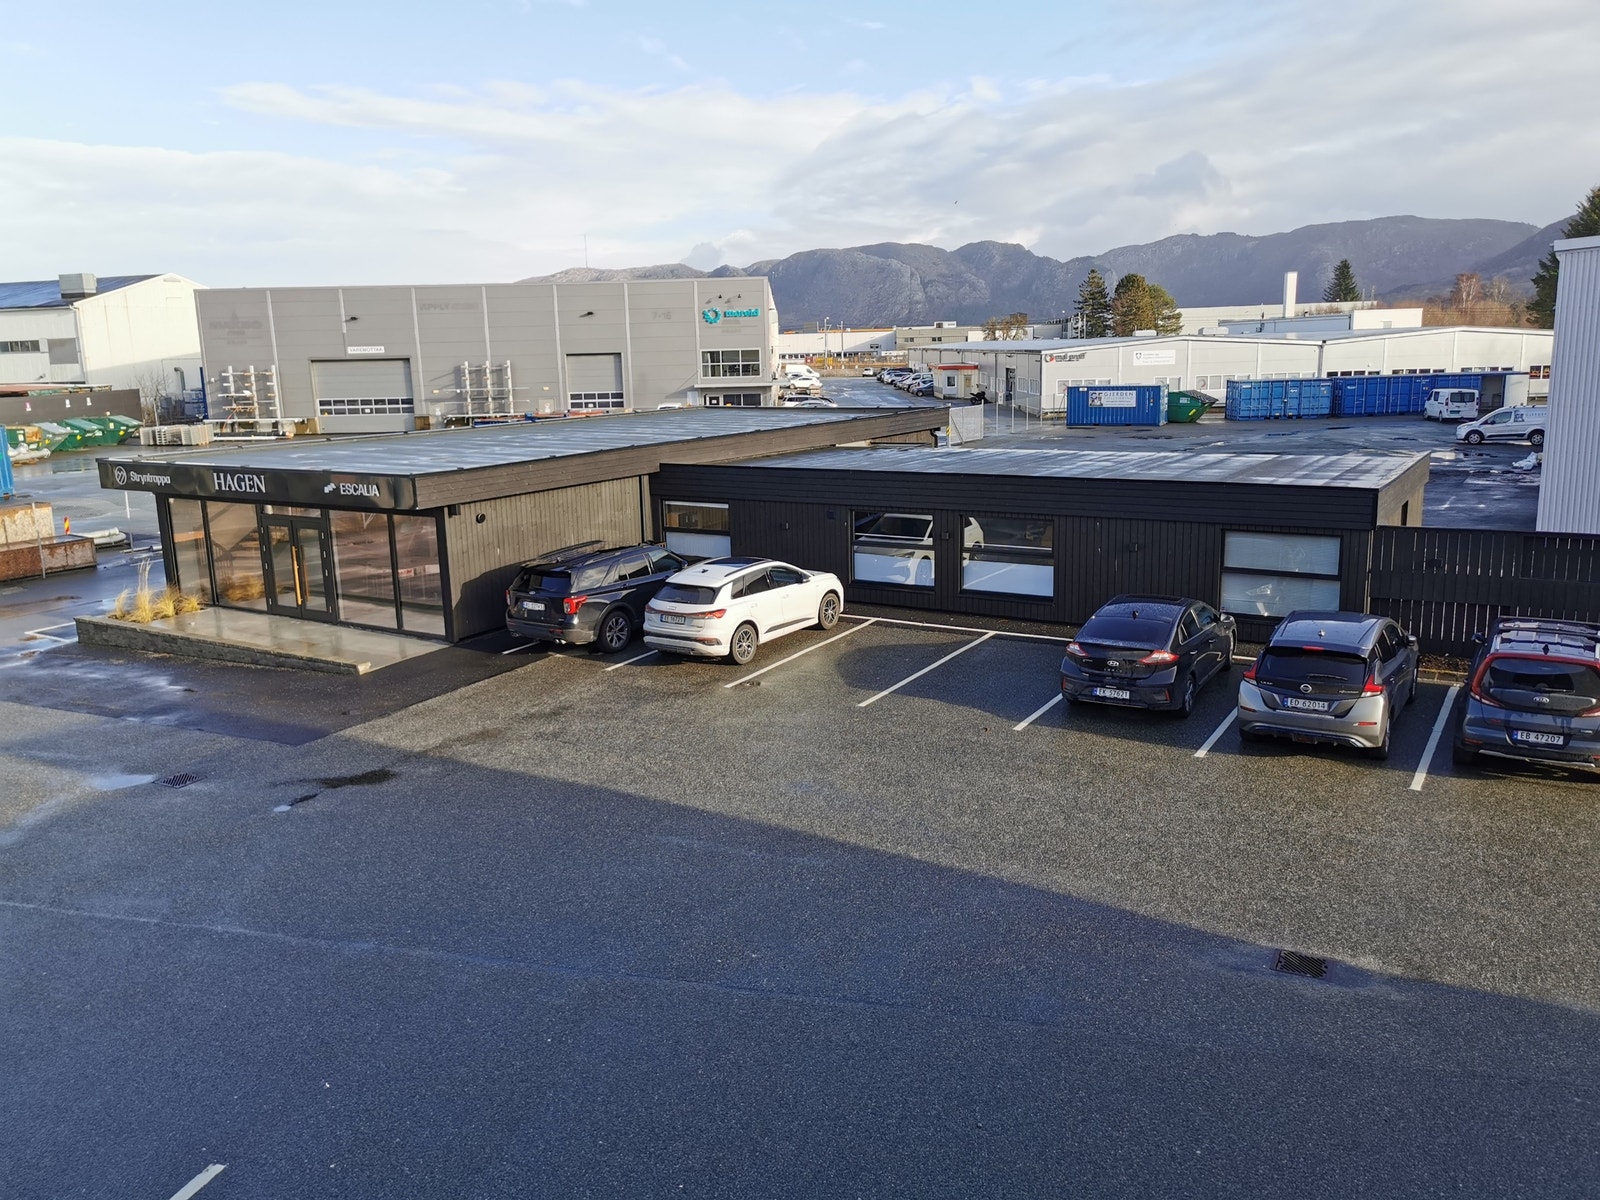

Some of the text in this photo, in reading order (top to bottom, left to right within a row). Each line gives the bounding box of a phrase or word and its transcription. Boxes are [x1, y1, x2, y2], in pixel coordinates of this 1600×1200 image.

[130, 471, 171, 486] Stryntrappa
[213, 472, 266, 493] HAGEN
[340, 483, 380, 497] ESCALIA
[1290, 698, 1326, 710] ED 62014
[1520, 731, 1561, 743] EB 47207
